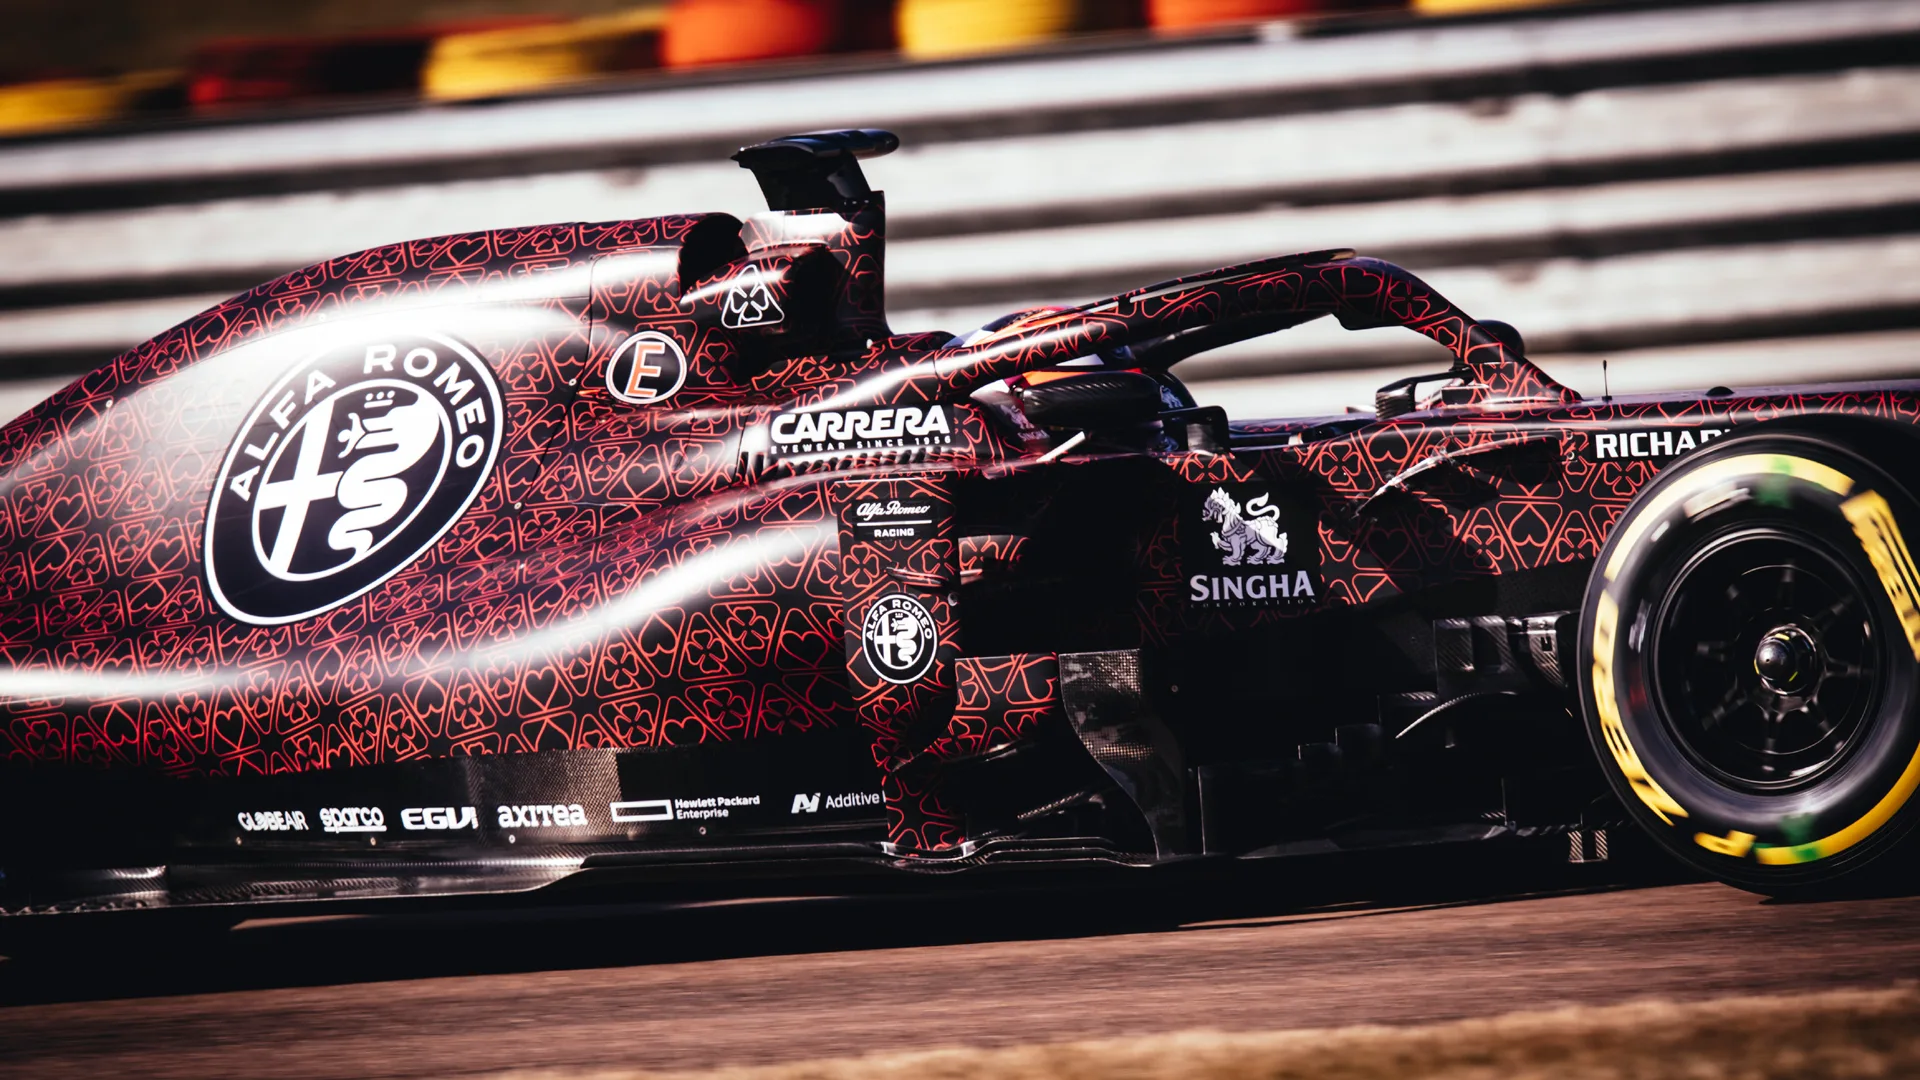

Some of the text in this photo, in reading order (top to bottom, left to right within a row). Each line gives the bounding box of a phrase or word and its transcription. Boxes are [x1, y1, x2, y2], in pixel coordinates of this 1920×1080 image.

[624, 341, 667, 398] E
[229, 343, 487, 502] ALFA ROMEO
[770, 404, 951, 445] CARRERA
[770, 435, 951, 455] EYEWEAR SINCE 1956
[1595, 429, 1731, 459] RICHA
[856, 500, 931, 521] Alfa Romeo
[873, 528, 915, 538] RACING
[1189, 570, 1315, 602] SINGHA
[1190, 598, 1318, 609] CORPORATION
[866, 599, 933, 641] ALFA ROMEO
[674, 795, 761, 809] Hewlett Packard
[825, 791, 880, 809] Additive
[319, 806, 386, 834] sparco
[676, 808, 729, 820] Enterprise
